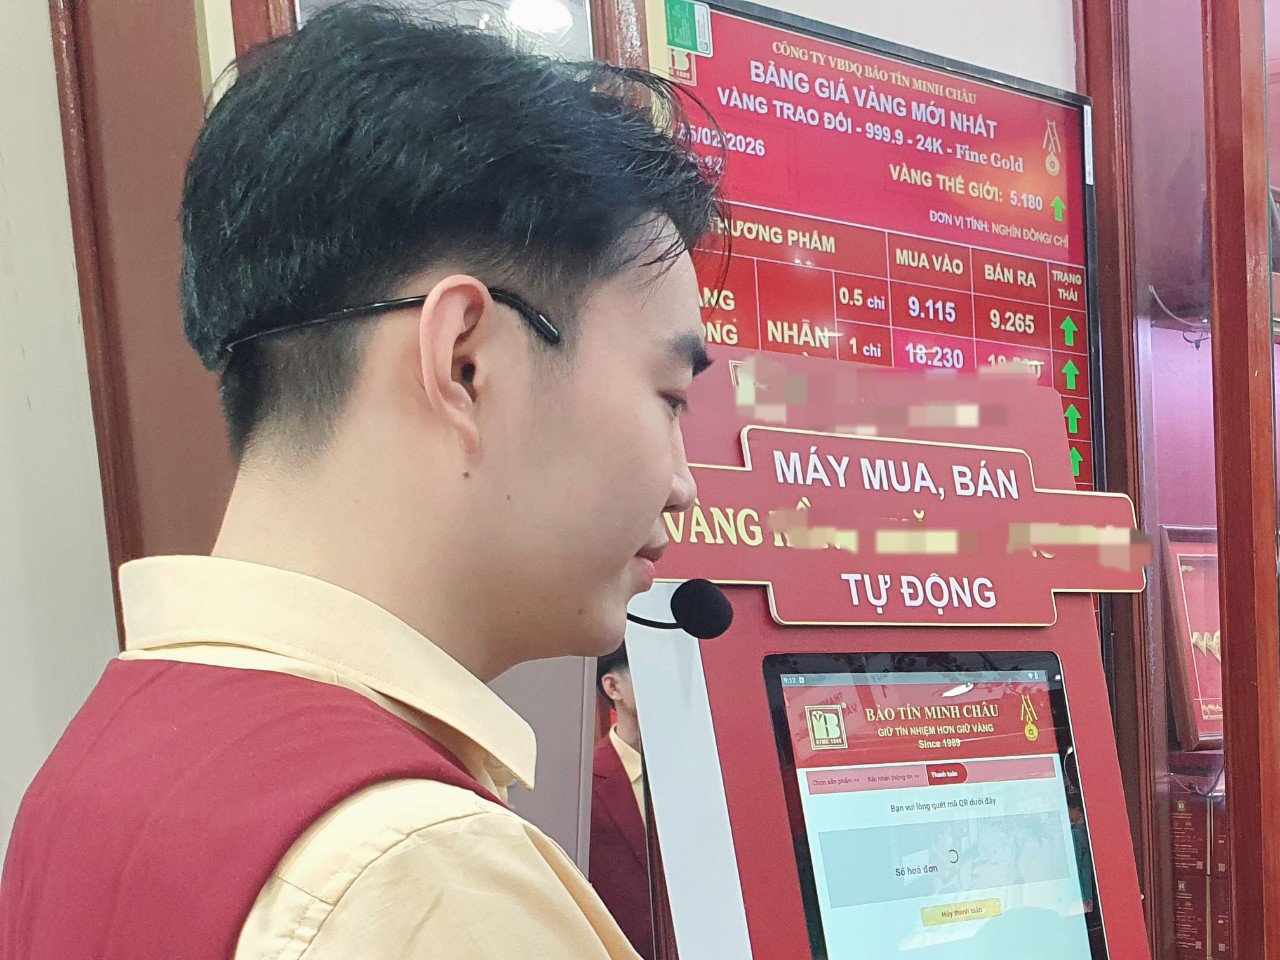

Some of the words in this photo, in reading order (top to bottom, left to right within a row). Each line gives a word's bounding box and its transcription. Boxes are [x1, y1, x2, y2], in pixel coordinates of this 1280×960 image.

[772, 41, 808, 61] CÔNG
[810, 51, 825, 66] TY
[865, 62, 888, 82] BẢO
[890, 71, 910, 88] TÍN
[912, 77, 943, 95] MINH
[945, 87, 976, 104] CHÂU
[750, 60, 809, 94] BẢNG
[815, 78, 849, 104] GIÁ
[853, 84, 906, 117] VÀNG
[911, 100, 945, 127] MỚI
[950, 111, 997, 139] NHẤT
[717, 86, 768, 114] VÀNG
[772, 100, 819, 126] TRAO
[865, 122, 904, 145] 999.9
[916, 134, 943, 155] 24K
[956, 143, 988, 164] Fine
[990, 154, 1024, 173] Gold
[889, 163, 932, 187] VÀNG
[936, 173, 965, 195] THẾ
[968, 181, 1003, 203] GIỚI:
[1010, 190, 1043, 211] 5.180
[929, 210, 952, 225] ĐƠN
[965, 217, 989, 233] TÍNH:
[991, 223, 1023, 240] NGHÌN
[787, 229, 836, 254] PHẨM
[895, 249, 930, 269] MUA
[932, 254, 964, 275] VÀO
[984, 263, 1014, 284] BÁN
[1017, 270, 1037, 288] RA
[1051, 270, 1082, 289] TRẠNG
[839, 286, 863, 307] 0.5
[1057, 287, 1078, 302] THÁI
[908, 296, 956, 323] 9.115
[990, 309, 1035, 334] 9.265
[849, 337, 858, 354] 1
[906, 343, 964, 369] 18.230
[773, 446, 850, 488] MÁY
[861, 458, 946, 501] MUA,
[952, 460, 1019, 500] BÁN
[662, 498, 763, 547] VÀNG
[840, 572, 892, 615] TỰ
[900, 572, 997, 615] ĐỘNG
[865, 704, 896, 721] BẢO
[898, 704, 921, 720] TÍN
[924, 706, 960, 720] MINH
[962, 702, 999, 718] CHÂU
[878, 726, 894, 737] GIỮ
[895, 725, 909, 736] TÍN
[910, 725, 936, 737] NHIỆM
[937, 725, 955, 735] HƠN
[957, 723, 971, 734] GIỮ
[971, 722, 995, 733] VÀNG
[918, 739, 941, 749] Since
[943, 738, 961, 748] 1989
[890, 804, 904, 813] Bạn
[905, 804, 916, 812] vui
[916, 802, 931, 812] lòng
[932, 801, 947, 810] quét
[947, 800, 958, 808] mã
[959, 799, 969, 808] QR
[969, 797, 984, 806] dưới
[984, 796, 996, 806] đây
[895, 867, 906, 877] Số
[923, 864, 939, 874] đơn
